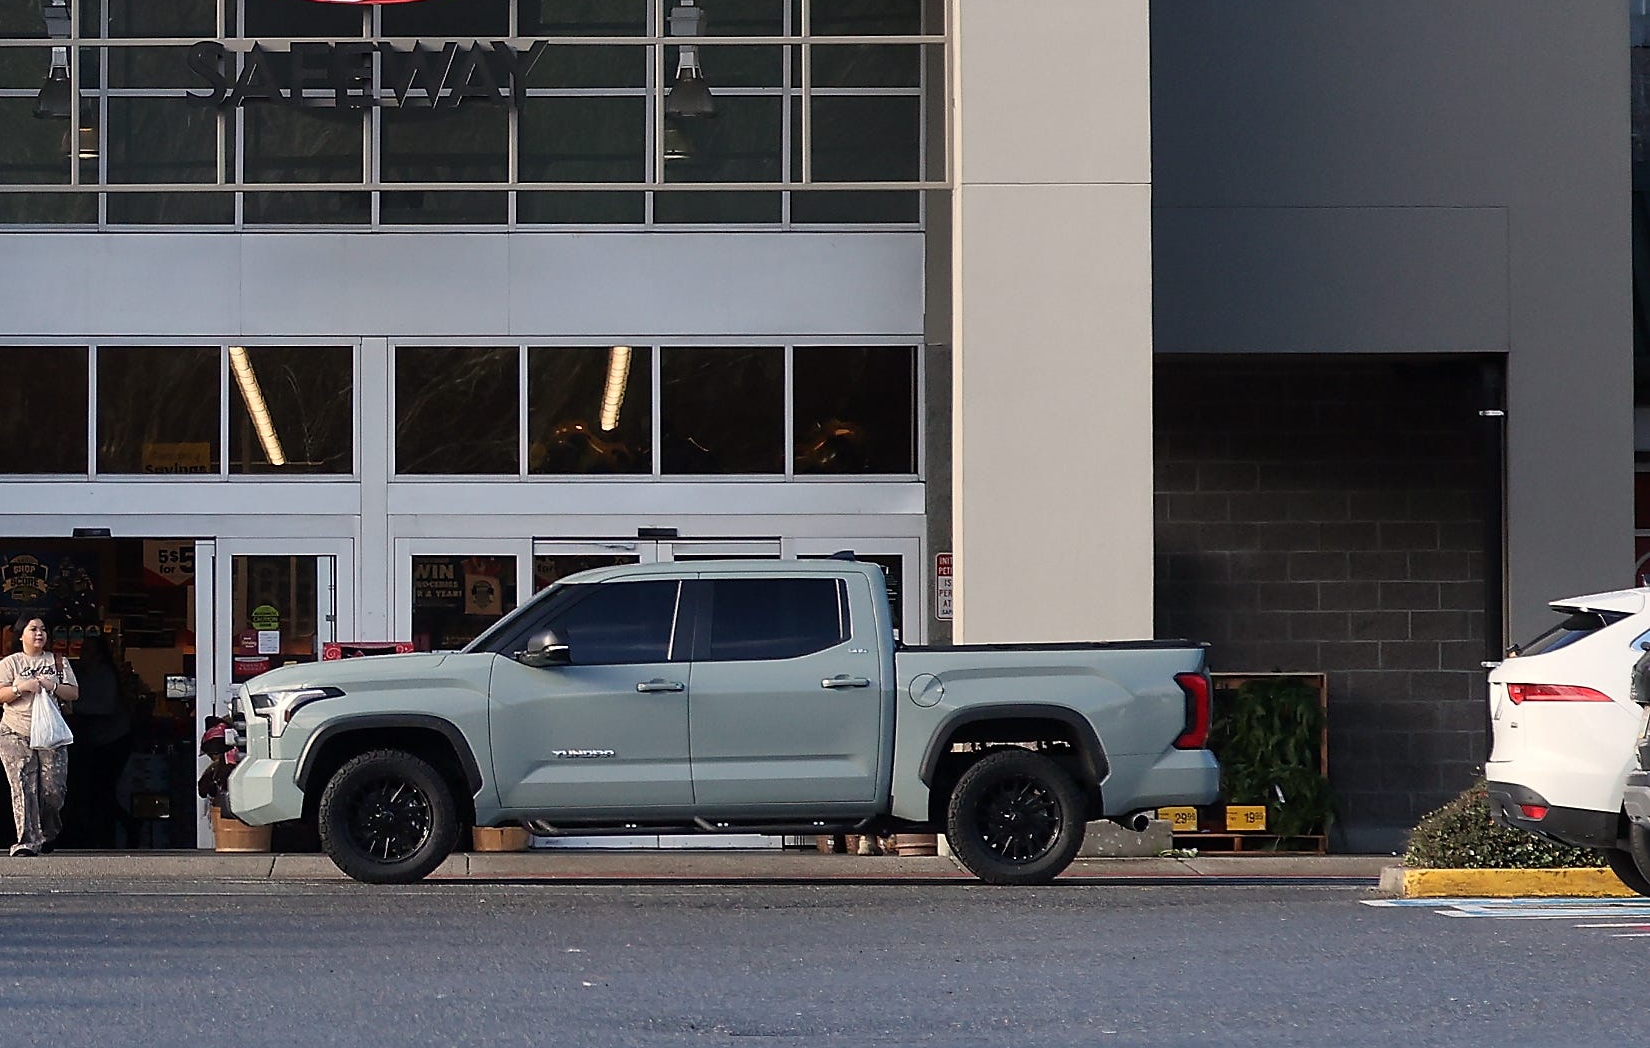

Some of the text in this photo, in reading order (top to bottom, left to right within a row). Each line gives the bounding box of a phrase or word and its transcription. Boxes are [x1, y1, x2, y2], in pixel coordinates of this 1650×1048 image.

[186, 40, 549, 108] SAFEWAY
[13, 565, 36, 574] SHOP
[160, 565, 176, 574] for
[10, 576, 40, 588] SCORE
[551, 749, 616, 759] TUNDRA
